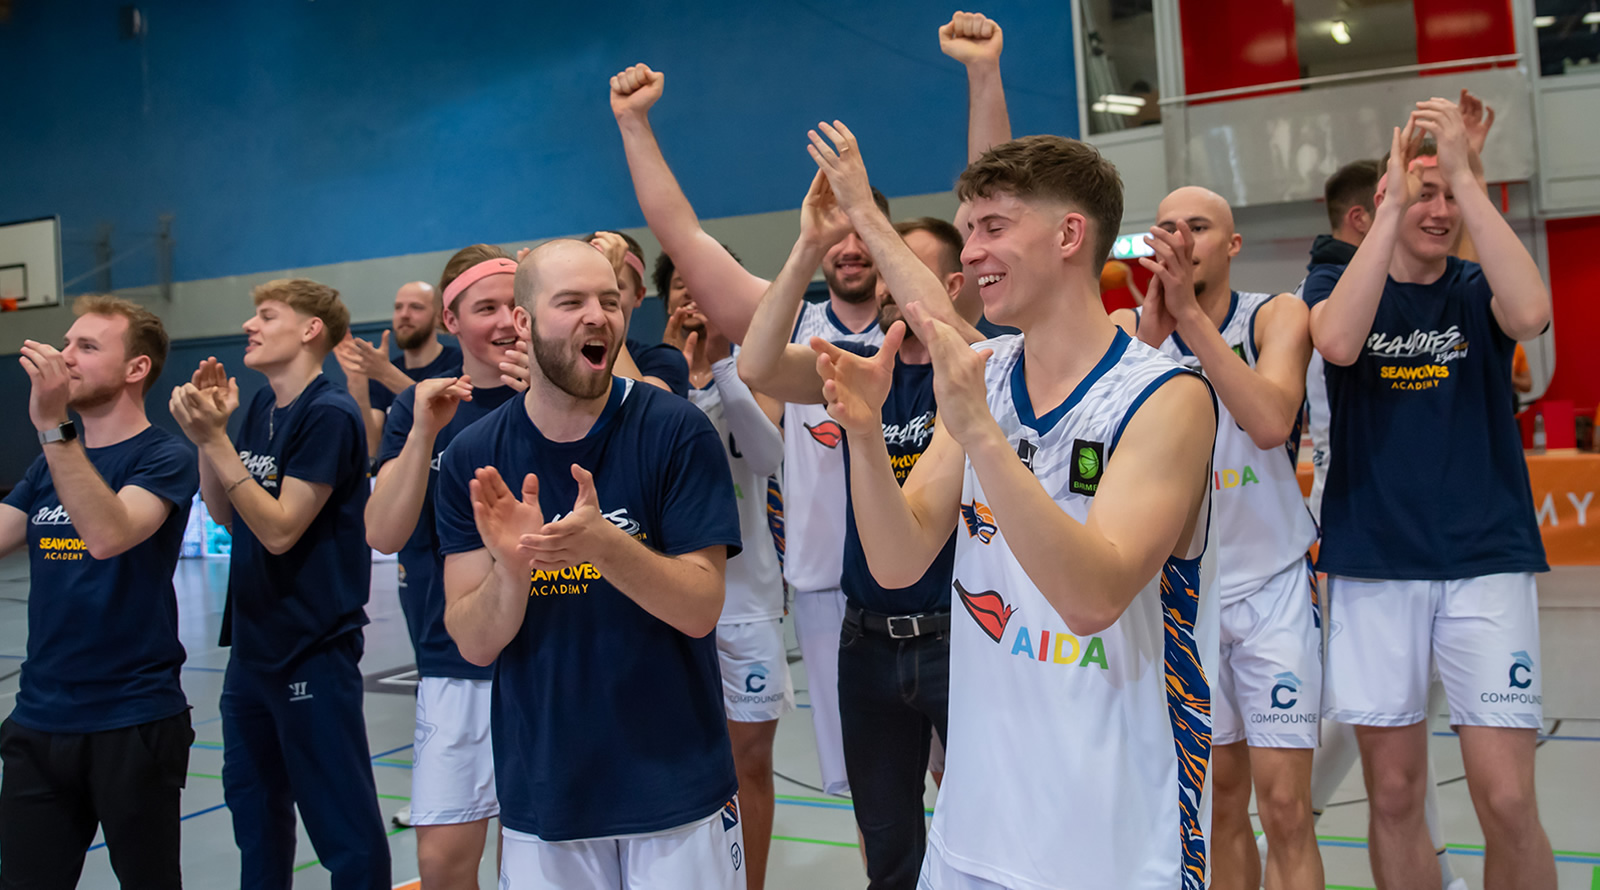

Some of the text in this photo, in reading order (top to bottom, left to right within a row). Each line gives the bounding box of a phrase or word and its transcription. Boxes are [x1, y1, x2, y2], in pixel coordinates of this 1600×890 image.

[1391, 380, 1439, 390] ACADEMY
[1214, 465, 1259, 490] IDA
[44, 552, 84, 560] ACADEMY
[530, 584, 589, 596] ACADEMY
[1011, 626, 1109, 670] AIDA
[1251, 713, 1317, 724] COMPOUNDE
